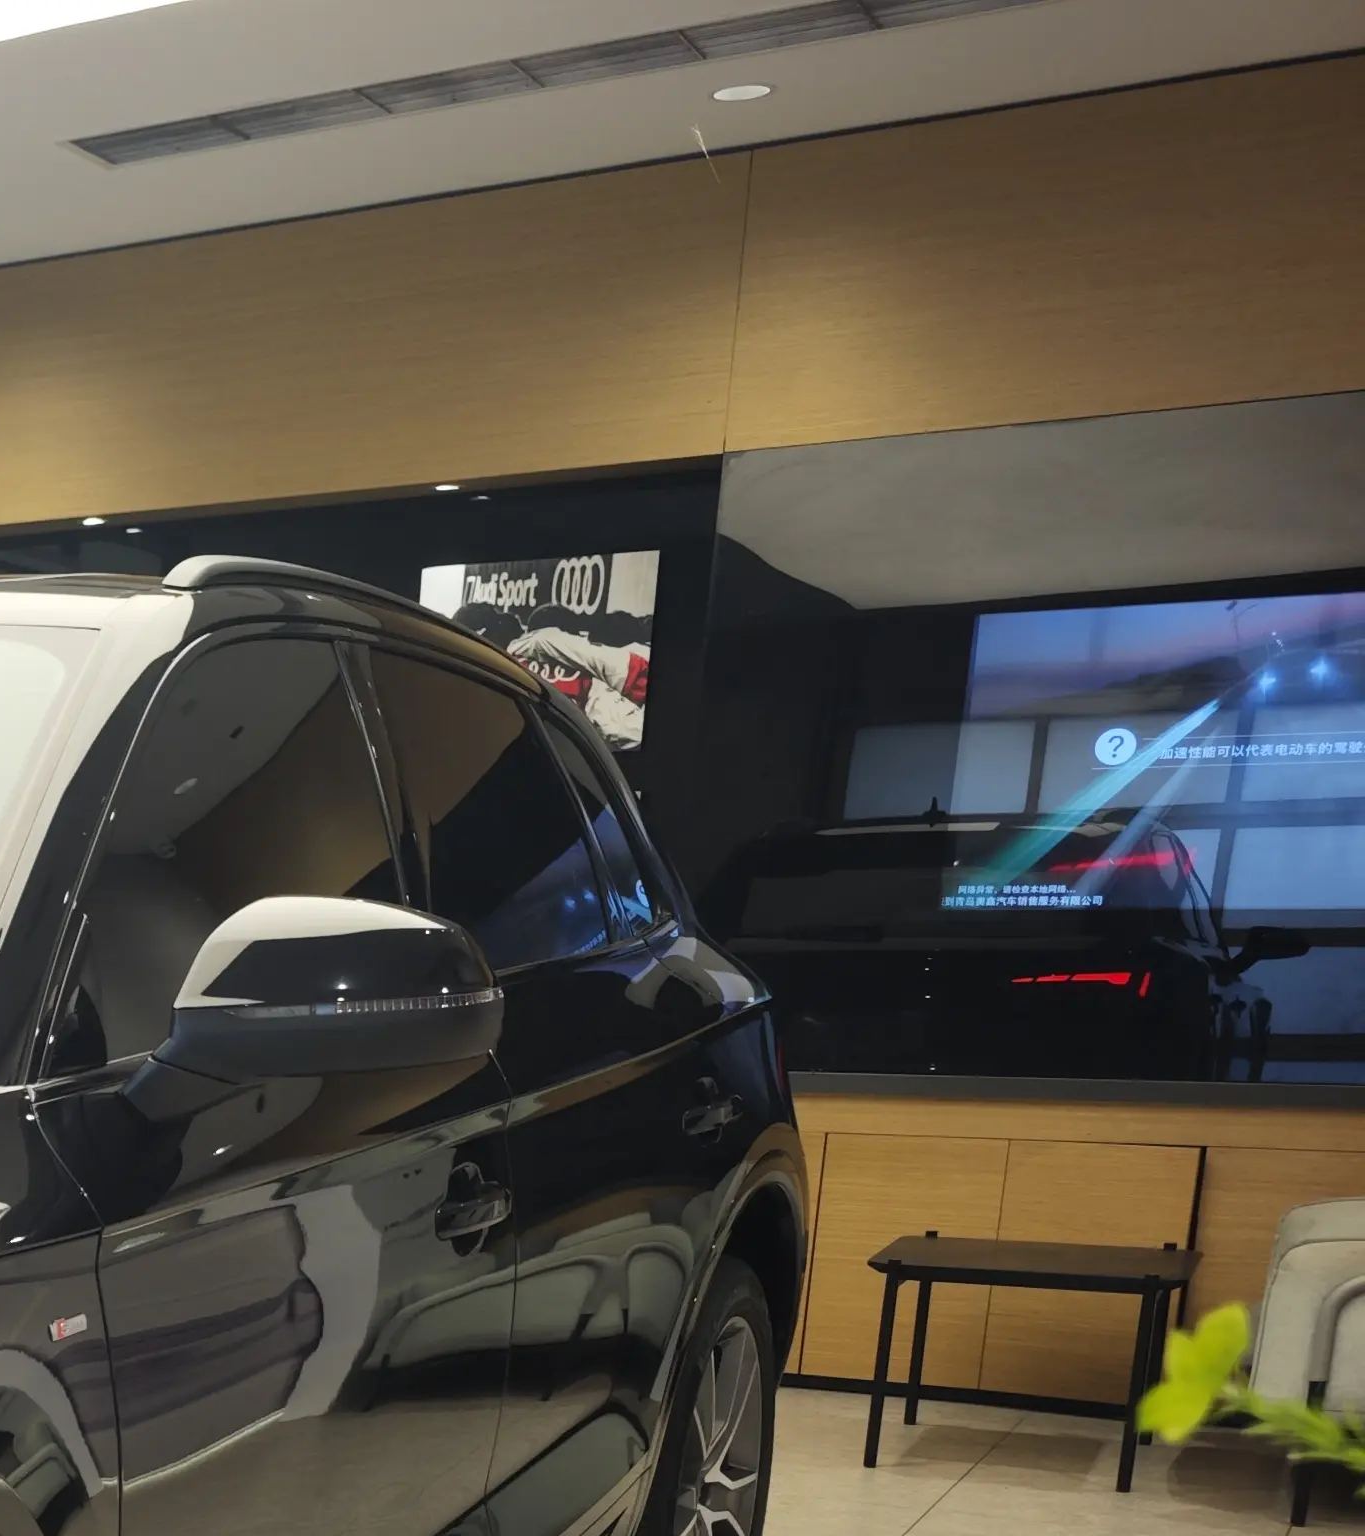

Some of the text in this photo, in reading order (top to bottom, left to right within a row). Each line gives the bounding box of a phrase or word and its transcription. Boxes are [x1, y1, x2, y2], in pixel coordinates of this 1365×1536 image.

[472, 571, 538, 613] Audi Sport
[1160, 740, 1365, 760] 加速性能可以代表电动车的驾驶
